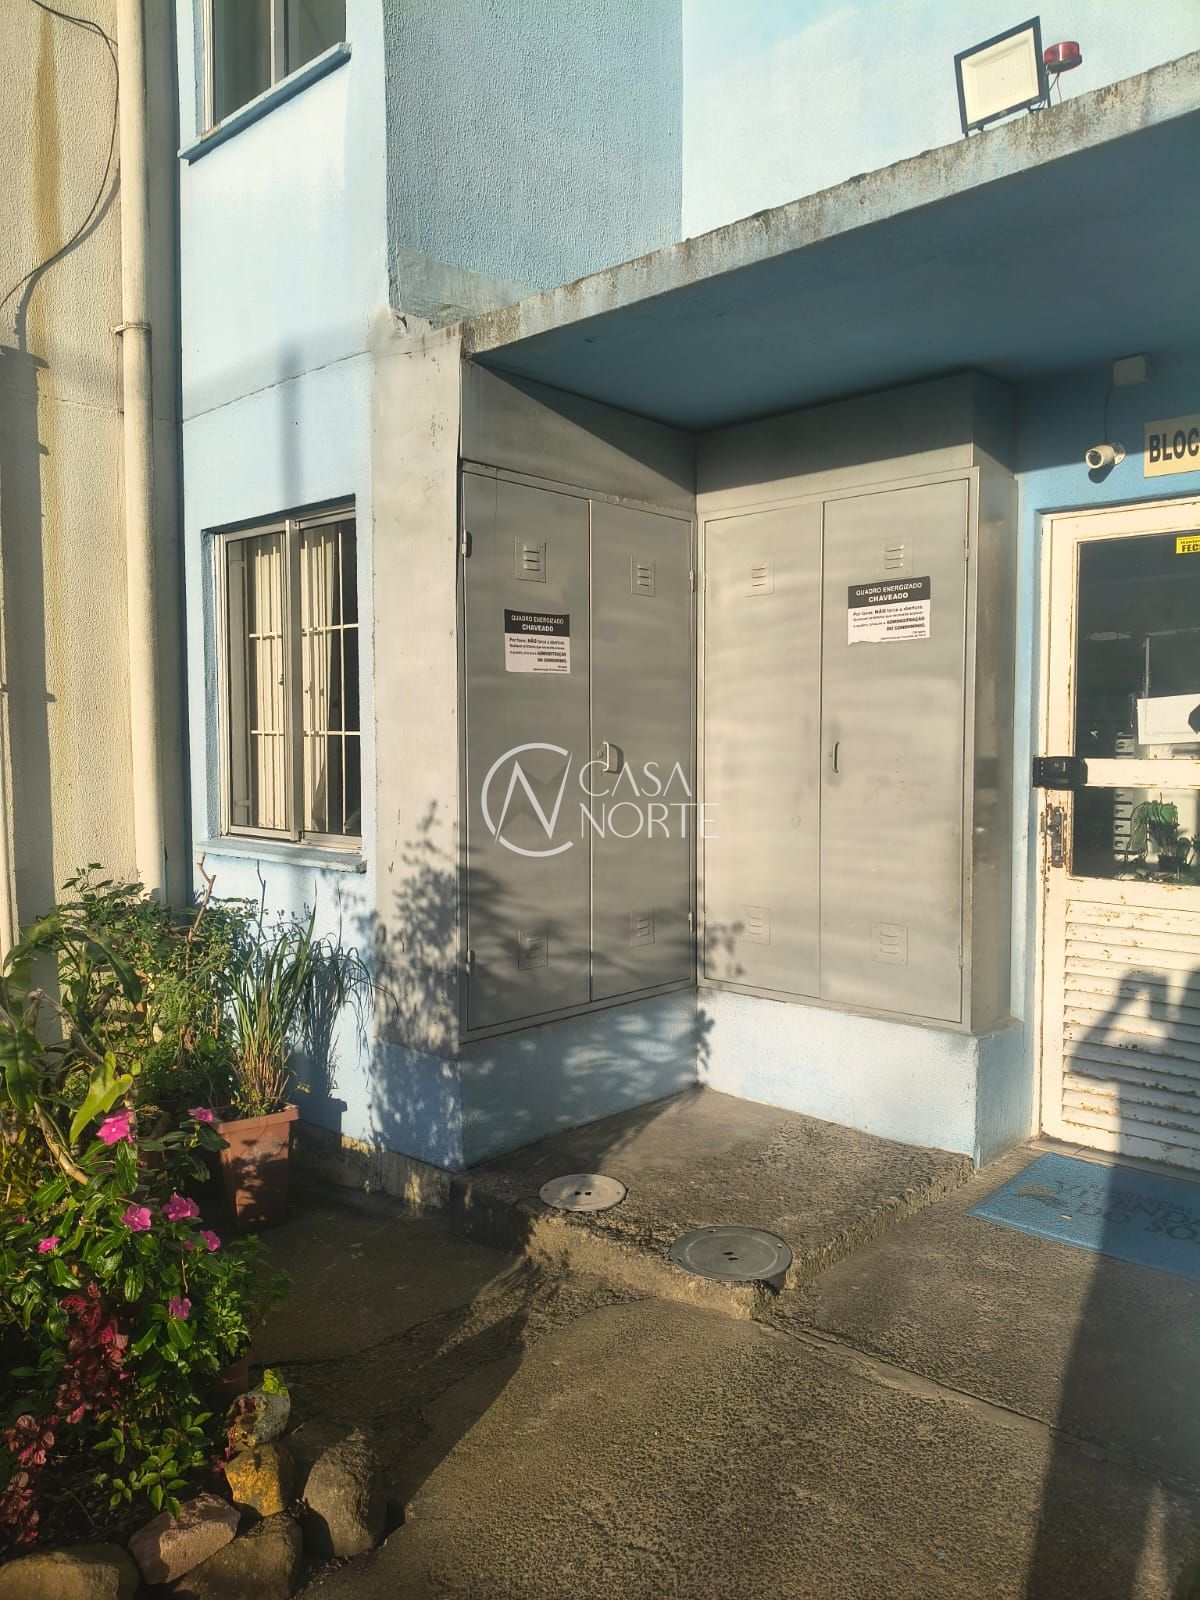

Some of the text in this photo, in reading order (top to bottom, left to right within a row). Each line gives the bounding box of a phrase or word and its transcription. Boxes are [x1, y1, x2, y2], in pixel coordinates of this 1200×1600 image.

[1149, 428, 1200, 463] BLOC
[856, 582, 922, 596] QUADRO ENERGIZADO
[868, 592, 909, 603] CHAVEADO
